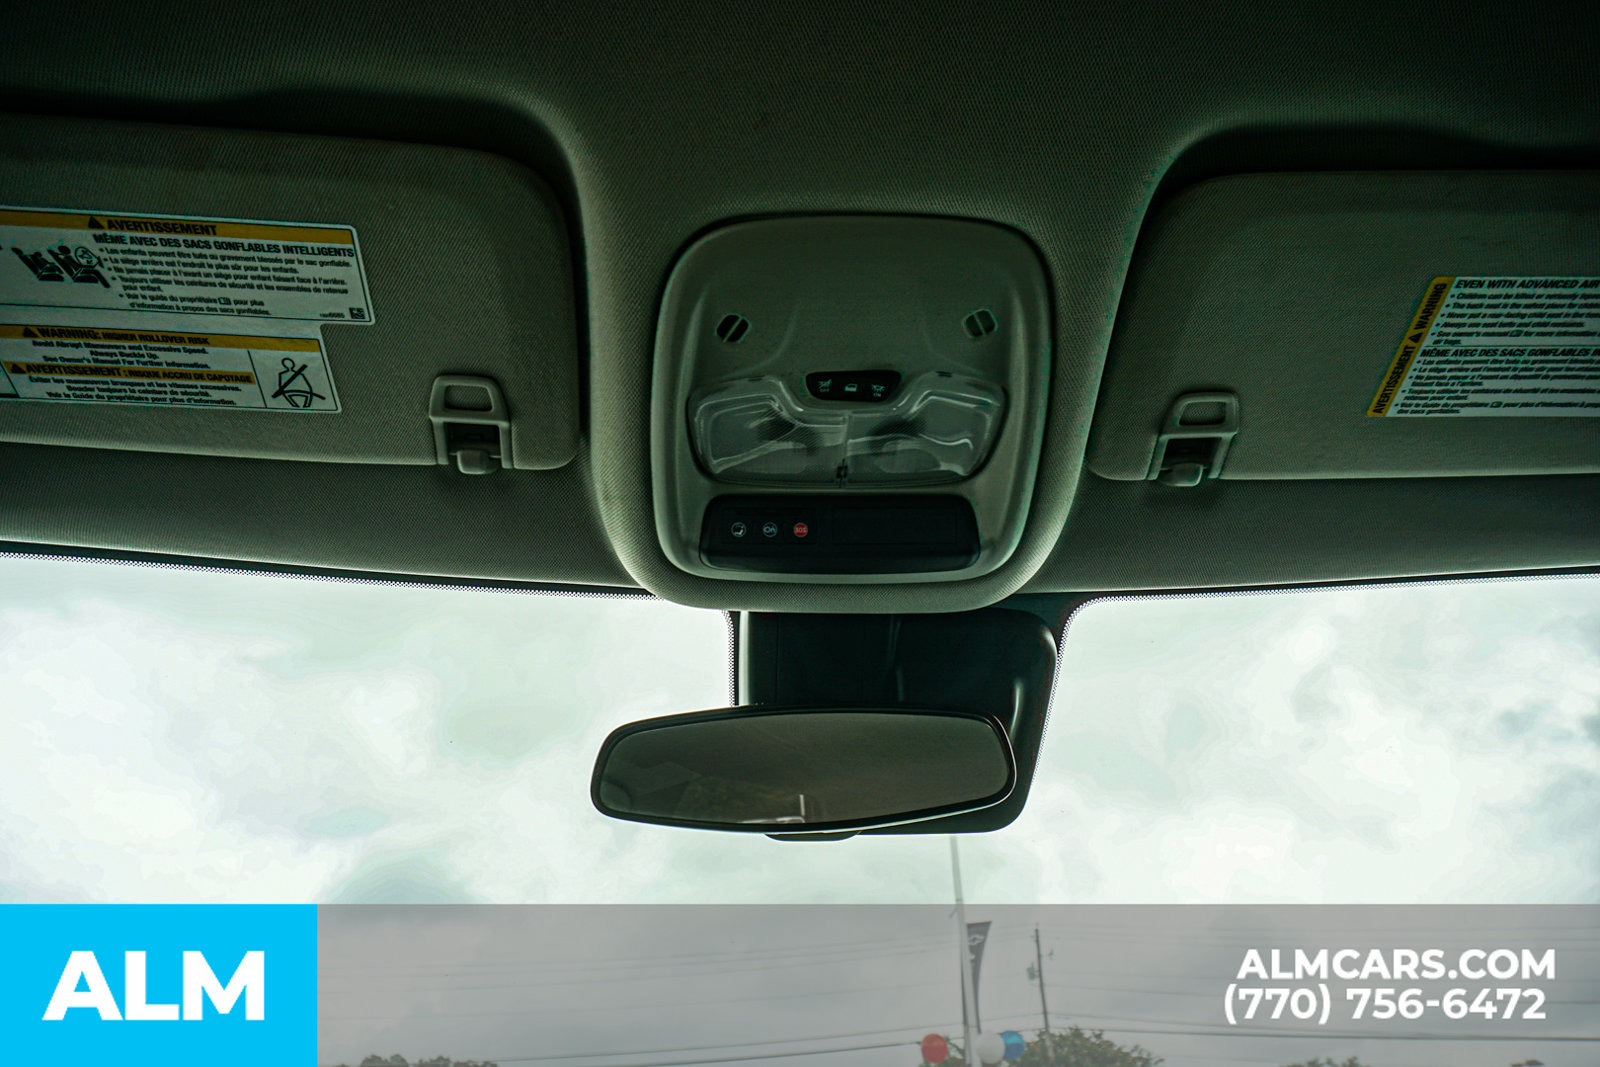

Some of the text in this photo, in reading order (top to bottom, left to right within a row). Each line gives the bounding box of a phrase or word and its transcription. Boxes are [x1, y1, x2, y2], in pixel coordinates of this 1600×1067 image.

[107, 219, 216, 236] AVERTISSEMENT
[93, 232, 354, 257] MÊME AVEC DES SACS GONFLABLES INTELLIGENTS
[1456, 279, 1485, 289] EVEN
[1487, 279, 1517, 289] WITH
[1518, 279, 1579, 289] ADVANCED
[1414, 283, 1447, 330] WARNING
[37, 328, 210, 345] WARNING: HIGHER ROLLOVER RISK
[1420, 347, 1450, 357] MÊME
[1451, 349, 1478, 357] AVEC
[1478, 349, 1499, 357] DES
[1499, 348, 1526, 357] SACS
[26, 364, 121, 376] AVERTISSEMENT
[128, 370, 160, 378] RISQUE
[161, 371, 192, 380] ACCRU
[206, 373, 252, 383] CAPOTAGE
[1373, 344, 1415, 414] AVERTISSEMENT
